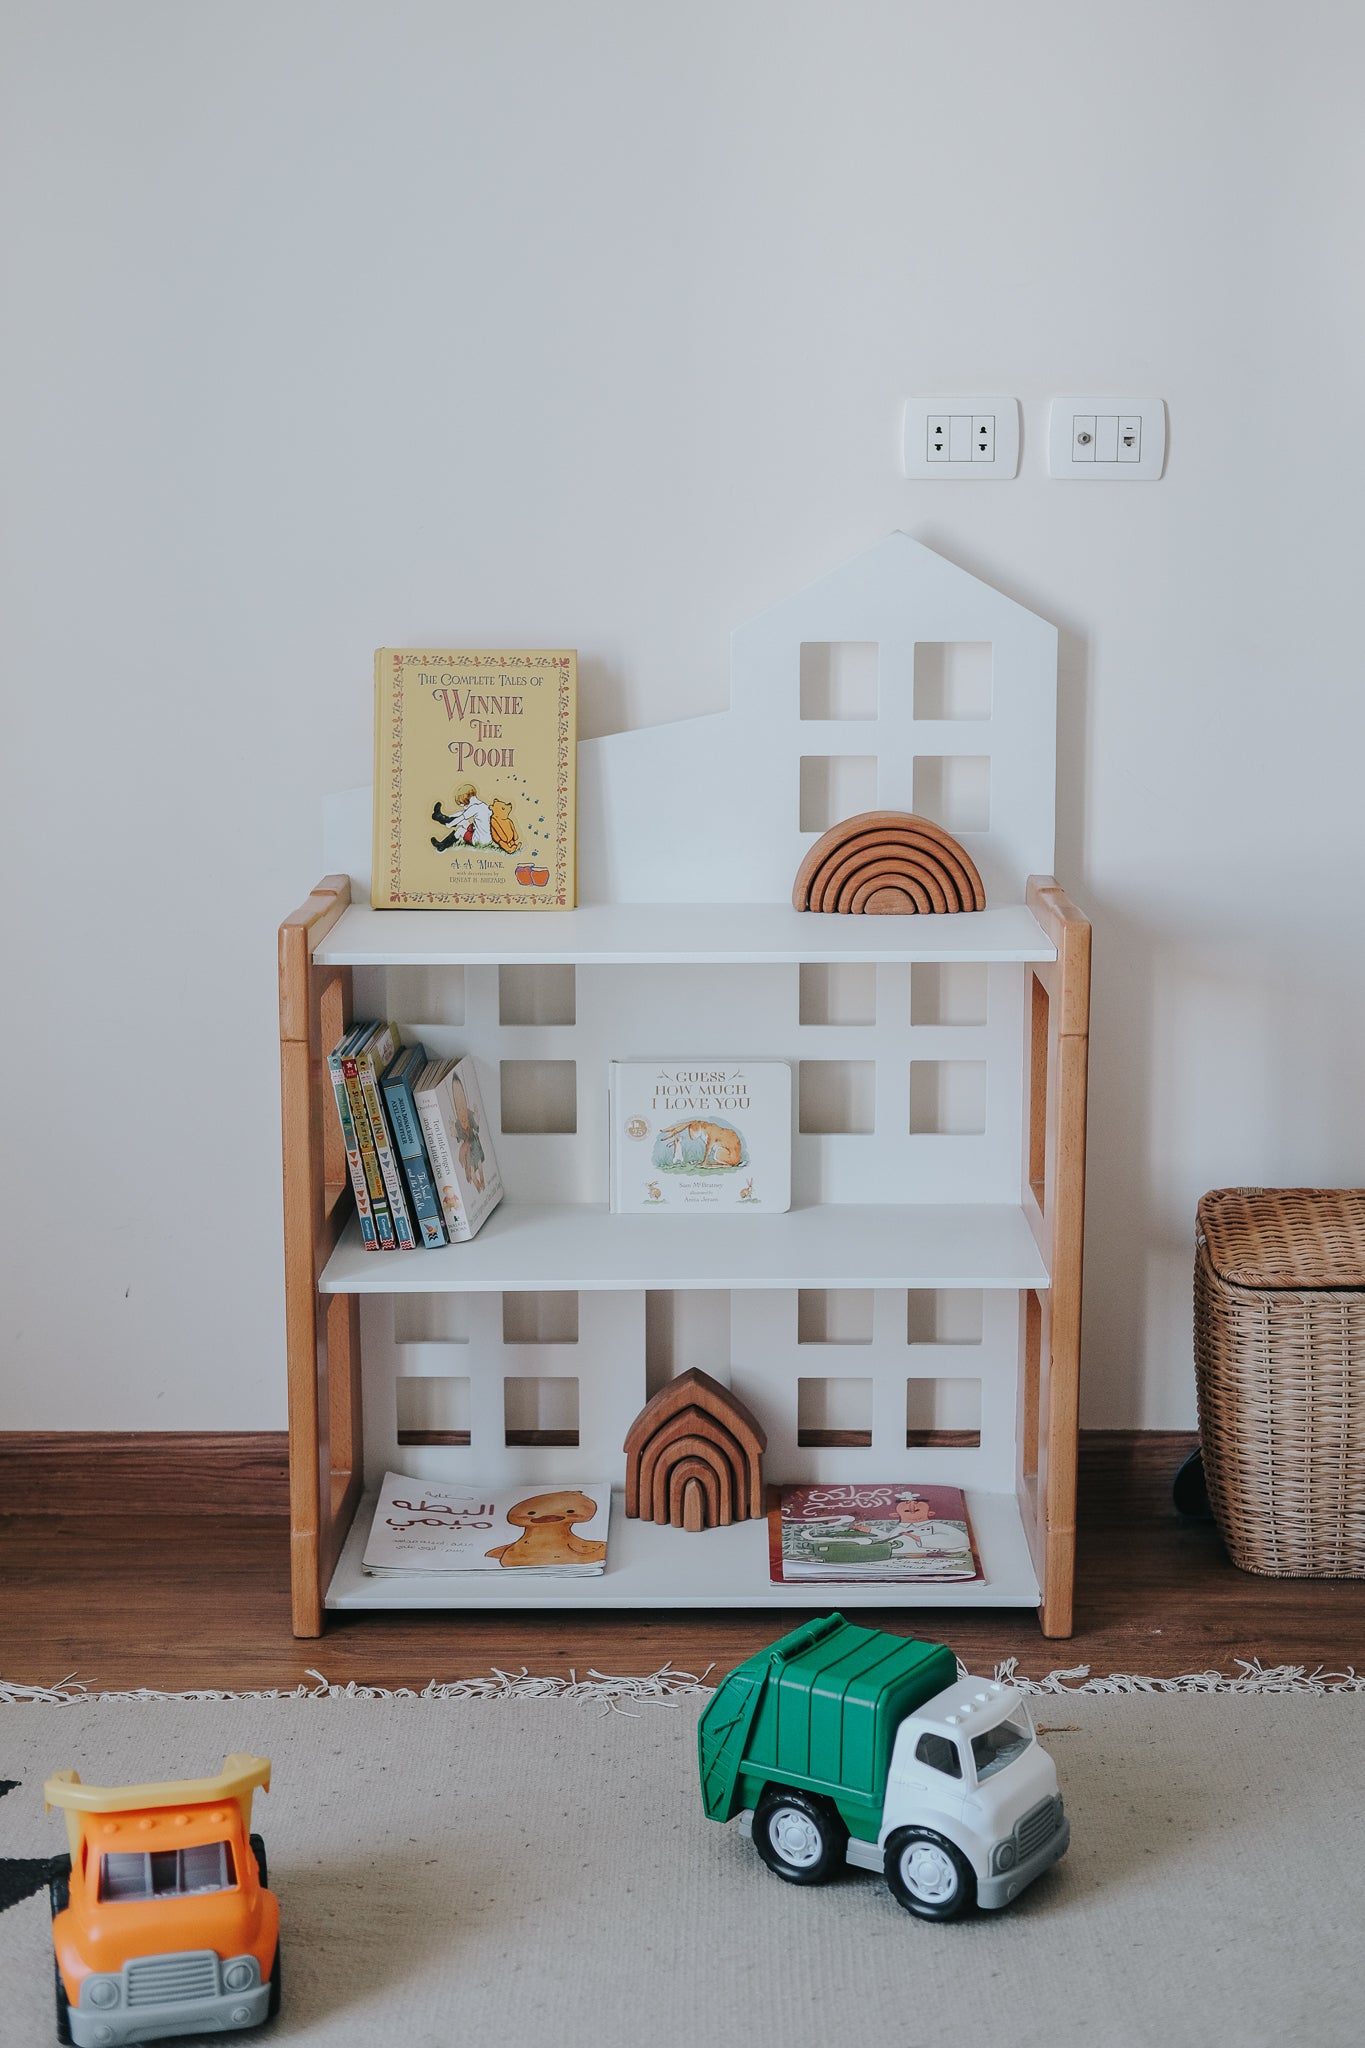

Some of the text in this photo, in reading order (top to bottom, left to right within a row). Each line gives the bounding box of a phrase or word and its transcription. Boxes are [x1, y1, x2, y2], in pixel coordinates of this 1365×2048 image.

[417, 673, 544, 687] THE COMPLETE TALES OF
[432, 688, 524, 721] WINNIE
[469, 718, 503, 742] THE
[447, 741, 515, 772] POOH
[676, 1071, 726, 1083] GUESS
[655, 1084, 747, 1096] HOW MUCH
[391, 1100, 399, 1115] AXEL
[652, 1097, 751, 1110] I LOVE YOU
[371, 1115, 385, 1141] KIND
[397, 1097, 415, 1144] JULIA DONALDSON
[423, 1117, 443, 1180] and Ten Little Toes
[437, 1132, 446, 1152] Little
[441, 1150, 451, 1176] Fingers
[385, 1518, 494, 1531] ميمي
